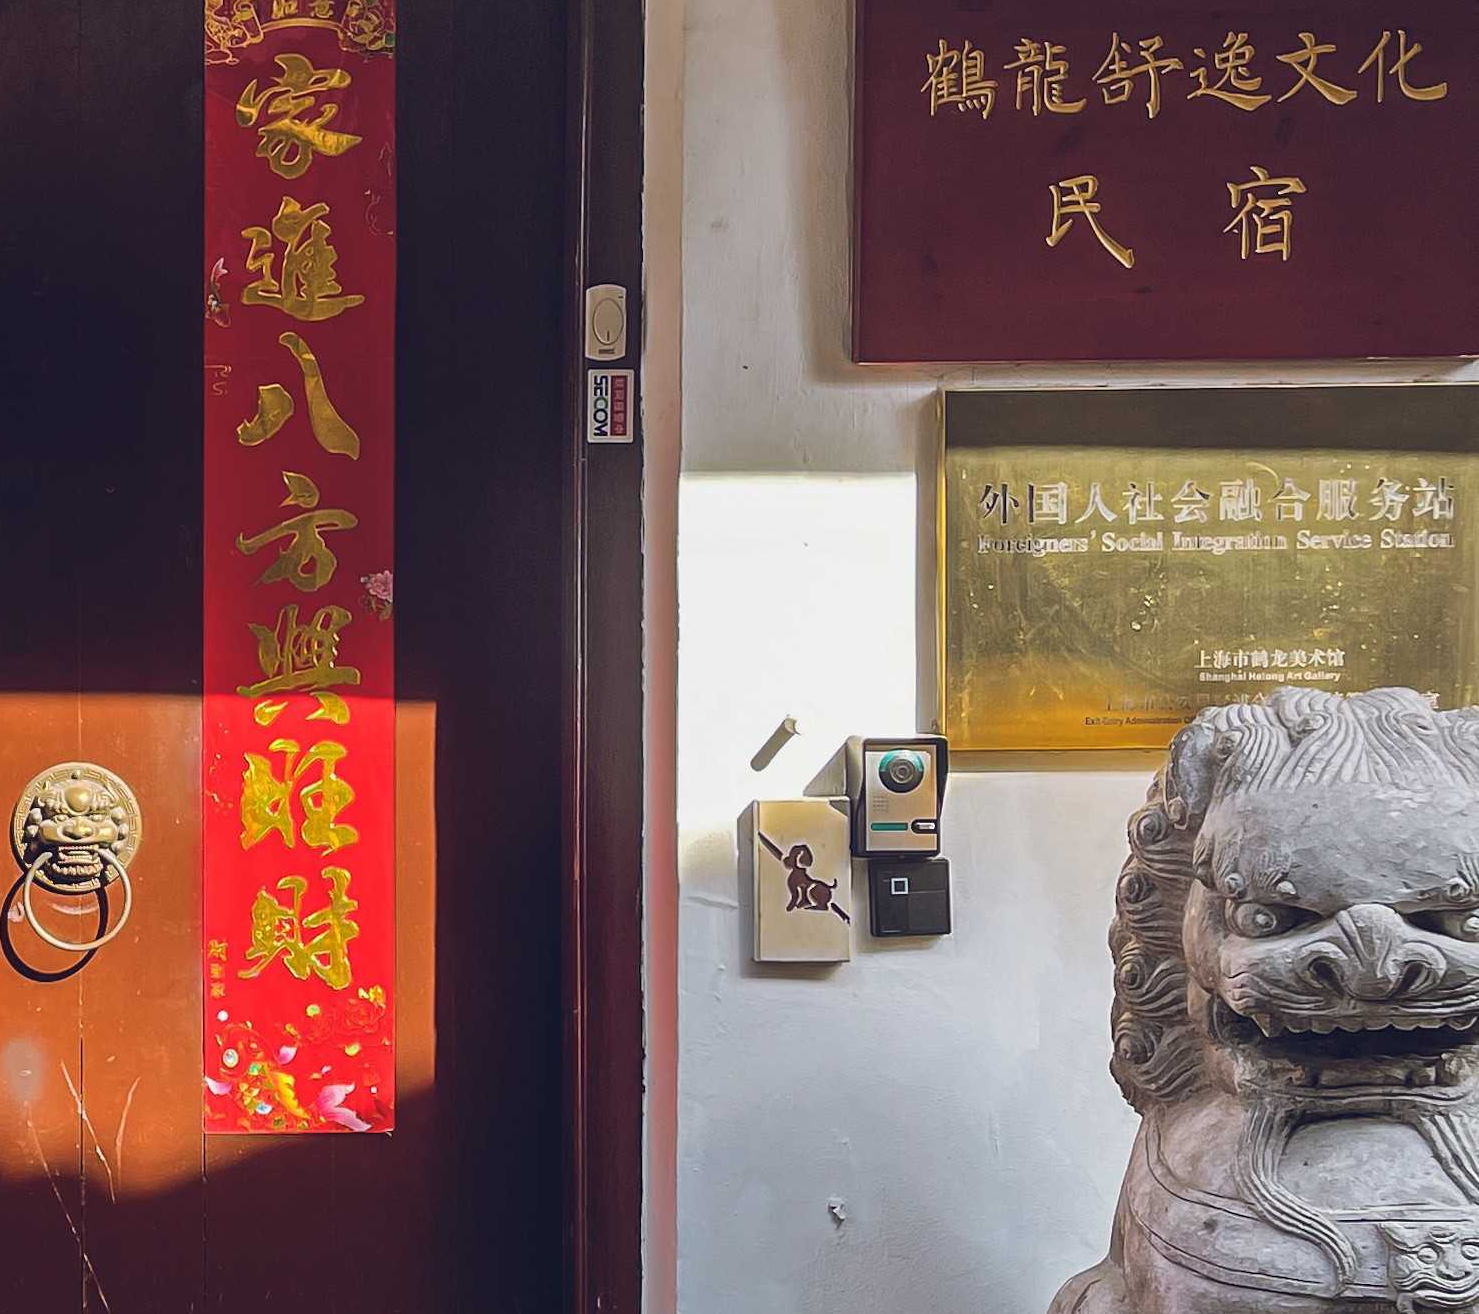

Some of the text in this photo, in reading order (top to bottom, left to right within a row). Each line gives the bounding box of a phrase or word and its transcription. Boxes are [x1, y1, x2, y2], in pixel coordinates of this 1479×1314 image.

[920, 29, 1448, 120] 鶴龍舒逸文化
[1044, 165, 1307, 270] 民宿
[593, 374, 609, 437] SECOM
[978, 476, 1456, 526] 外国人社会融合服务站
[1101, 531, 1164, 553] Social
[1171, 531, 1289, 555] Integration
[1296, 530, 1372, 550] Service
[1379, 528, 1456, 549] Station
[1194, 648, 1346, 669] 上海市鹤龙美术馆
